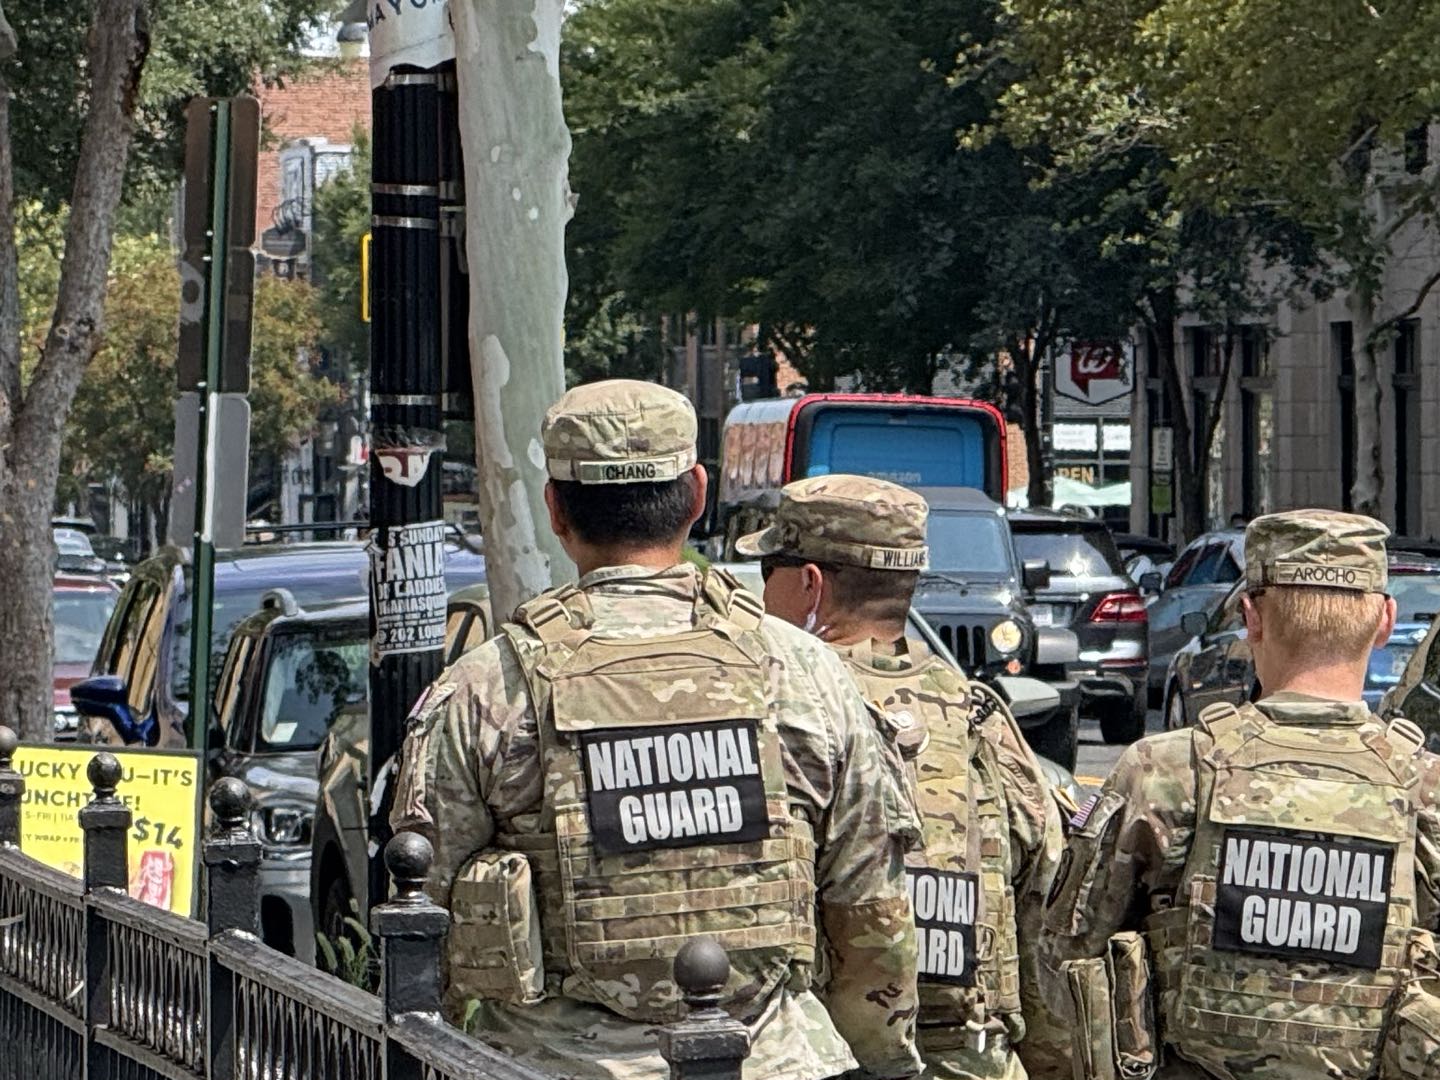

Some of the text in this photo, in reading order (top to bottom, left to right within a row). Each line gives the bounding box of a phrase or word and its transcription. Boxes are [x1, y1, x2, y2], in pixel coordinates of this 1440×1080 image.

[605, 464, 656, 480] CHANG
[1056, 466, 1094, 484] PEN
[1291, 567, 1356, 584] AROCHO
[389, 627, 416, 643] 202
[19, 760, 82, 780] UCKY
[587, 728, 760, 792] NATIONAL
[618, 785, 744, 844] GUARD
[132, 816, 184, 850] $14
[1223, 838, 1387, 903] NATIONAL
[1240, 895, 1362, 954] GUARD
[915, 927, 965, 976] ARD
